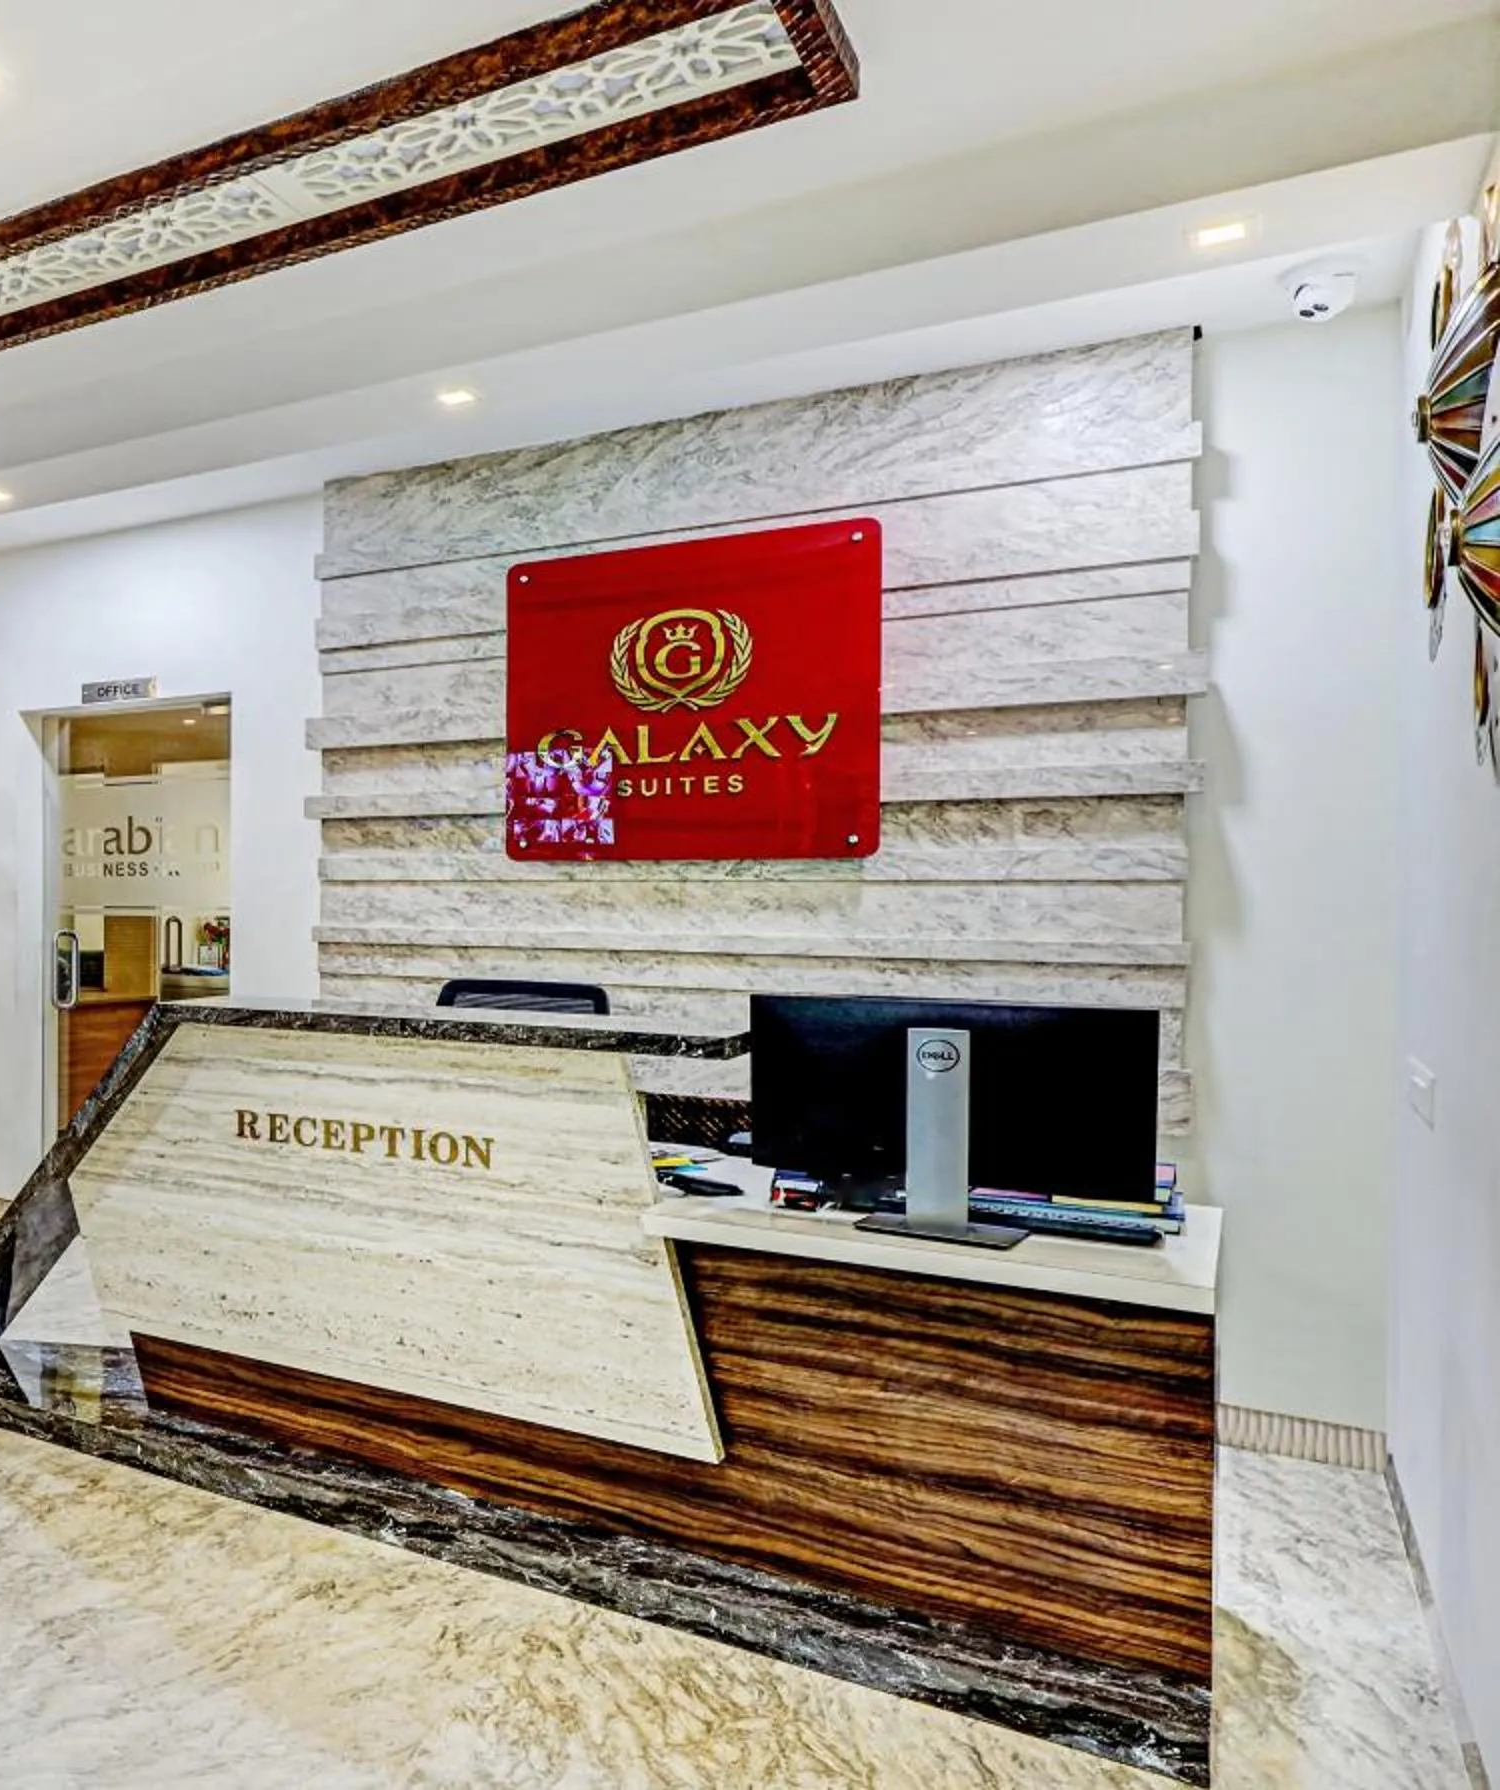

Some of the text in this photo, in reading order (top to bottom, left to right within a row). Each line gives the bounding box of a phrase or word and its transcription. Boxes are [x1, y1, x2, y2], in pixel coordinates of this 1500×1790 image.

[654, 641, 702, 680] G
[97, 683, 142, 697] OFFICE
[537, 712, 838, 768] GALAXY
[617, 775, 745, 798] SUITES
[235, 1108, 495, 1170] RECEPTION
